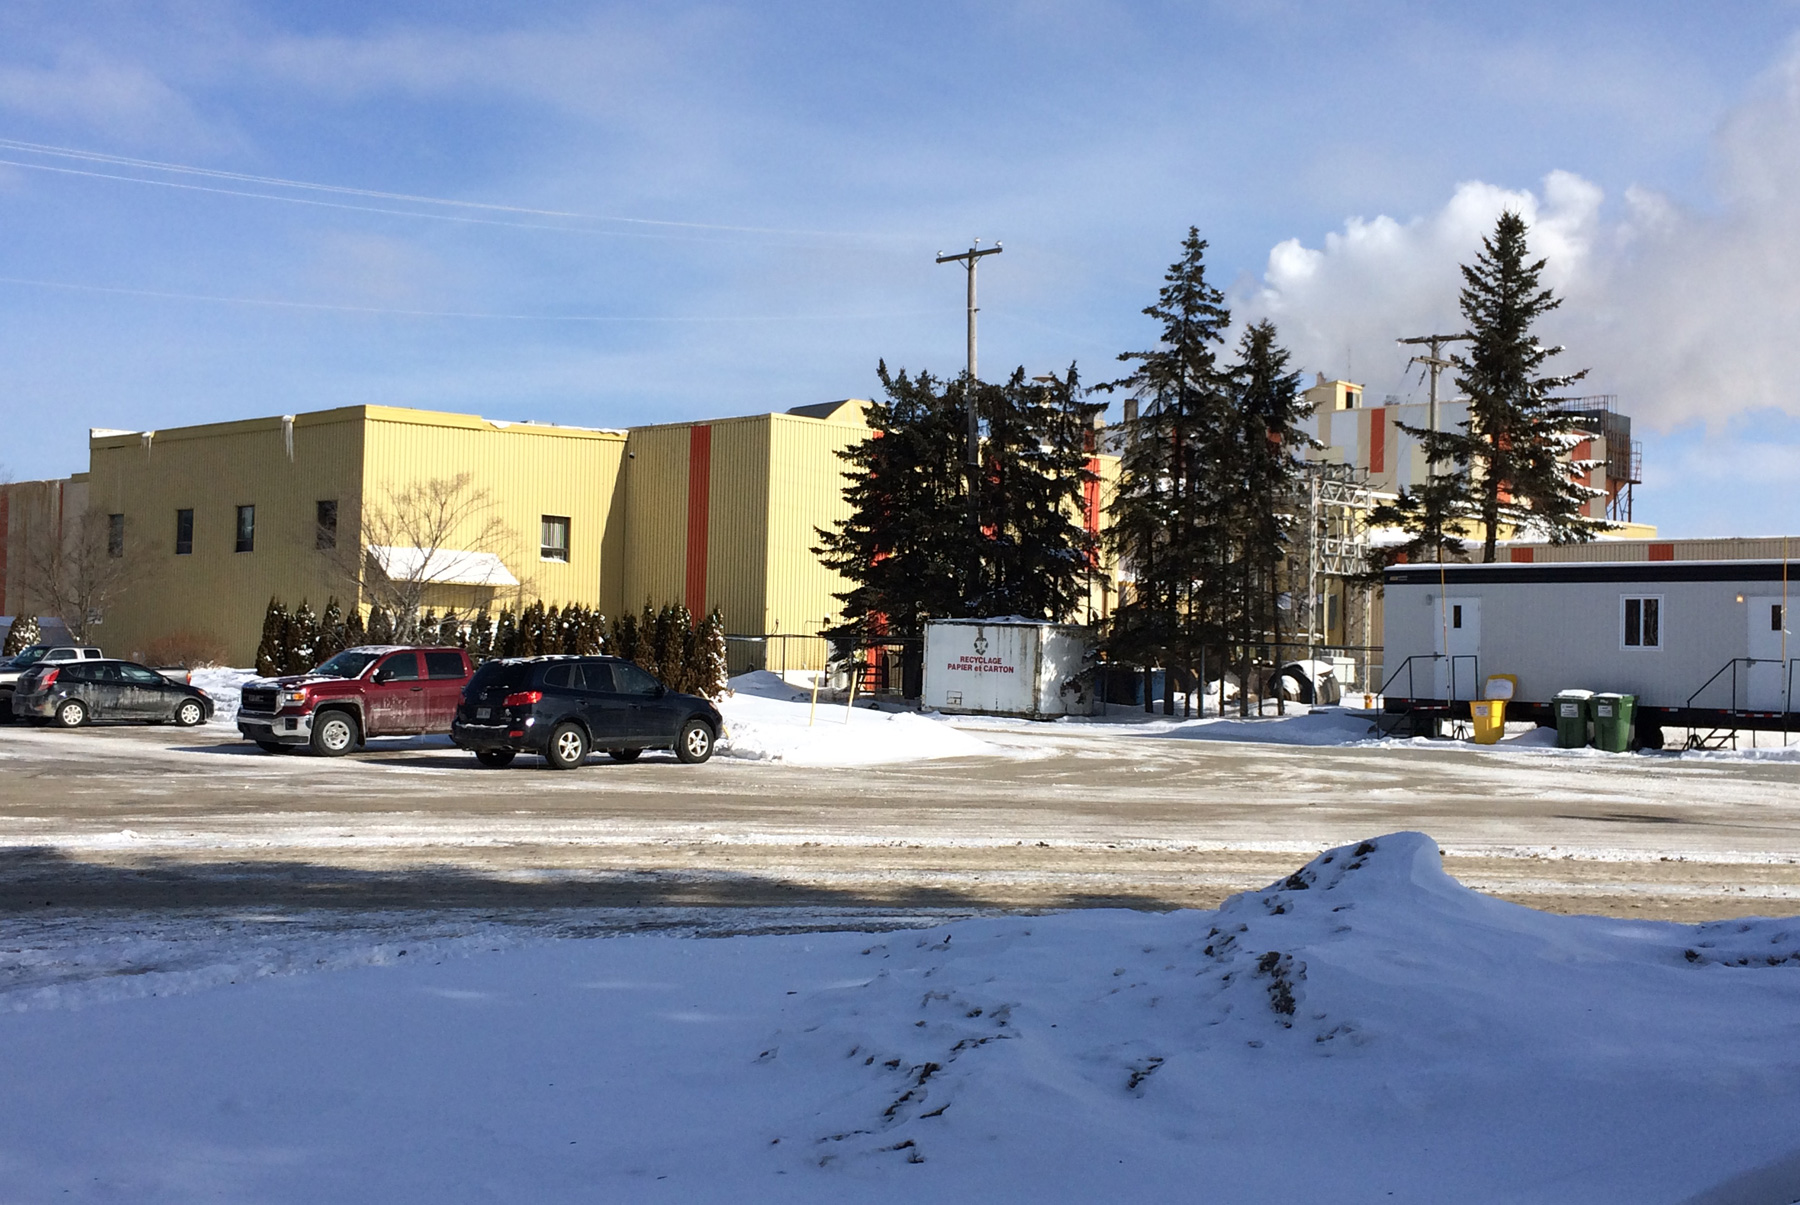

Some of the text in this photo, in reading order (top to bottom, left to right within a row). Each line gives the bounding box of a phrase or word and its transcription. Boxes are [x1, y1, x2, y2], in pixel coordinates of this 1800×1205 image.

[960, 656, 1002, 664] RECYCLAGE
[947, 663, 973, 671] PAPIER
[983, 665, 1014, 673] CARTON
